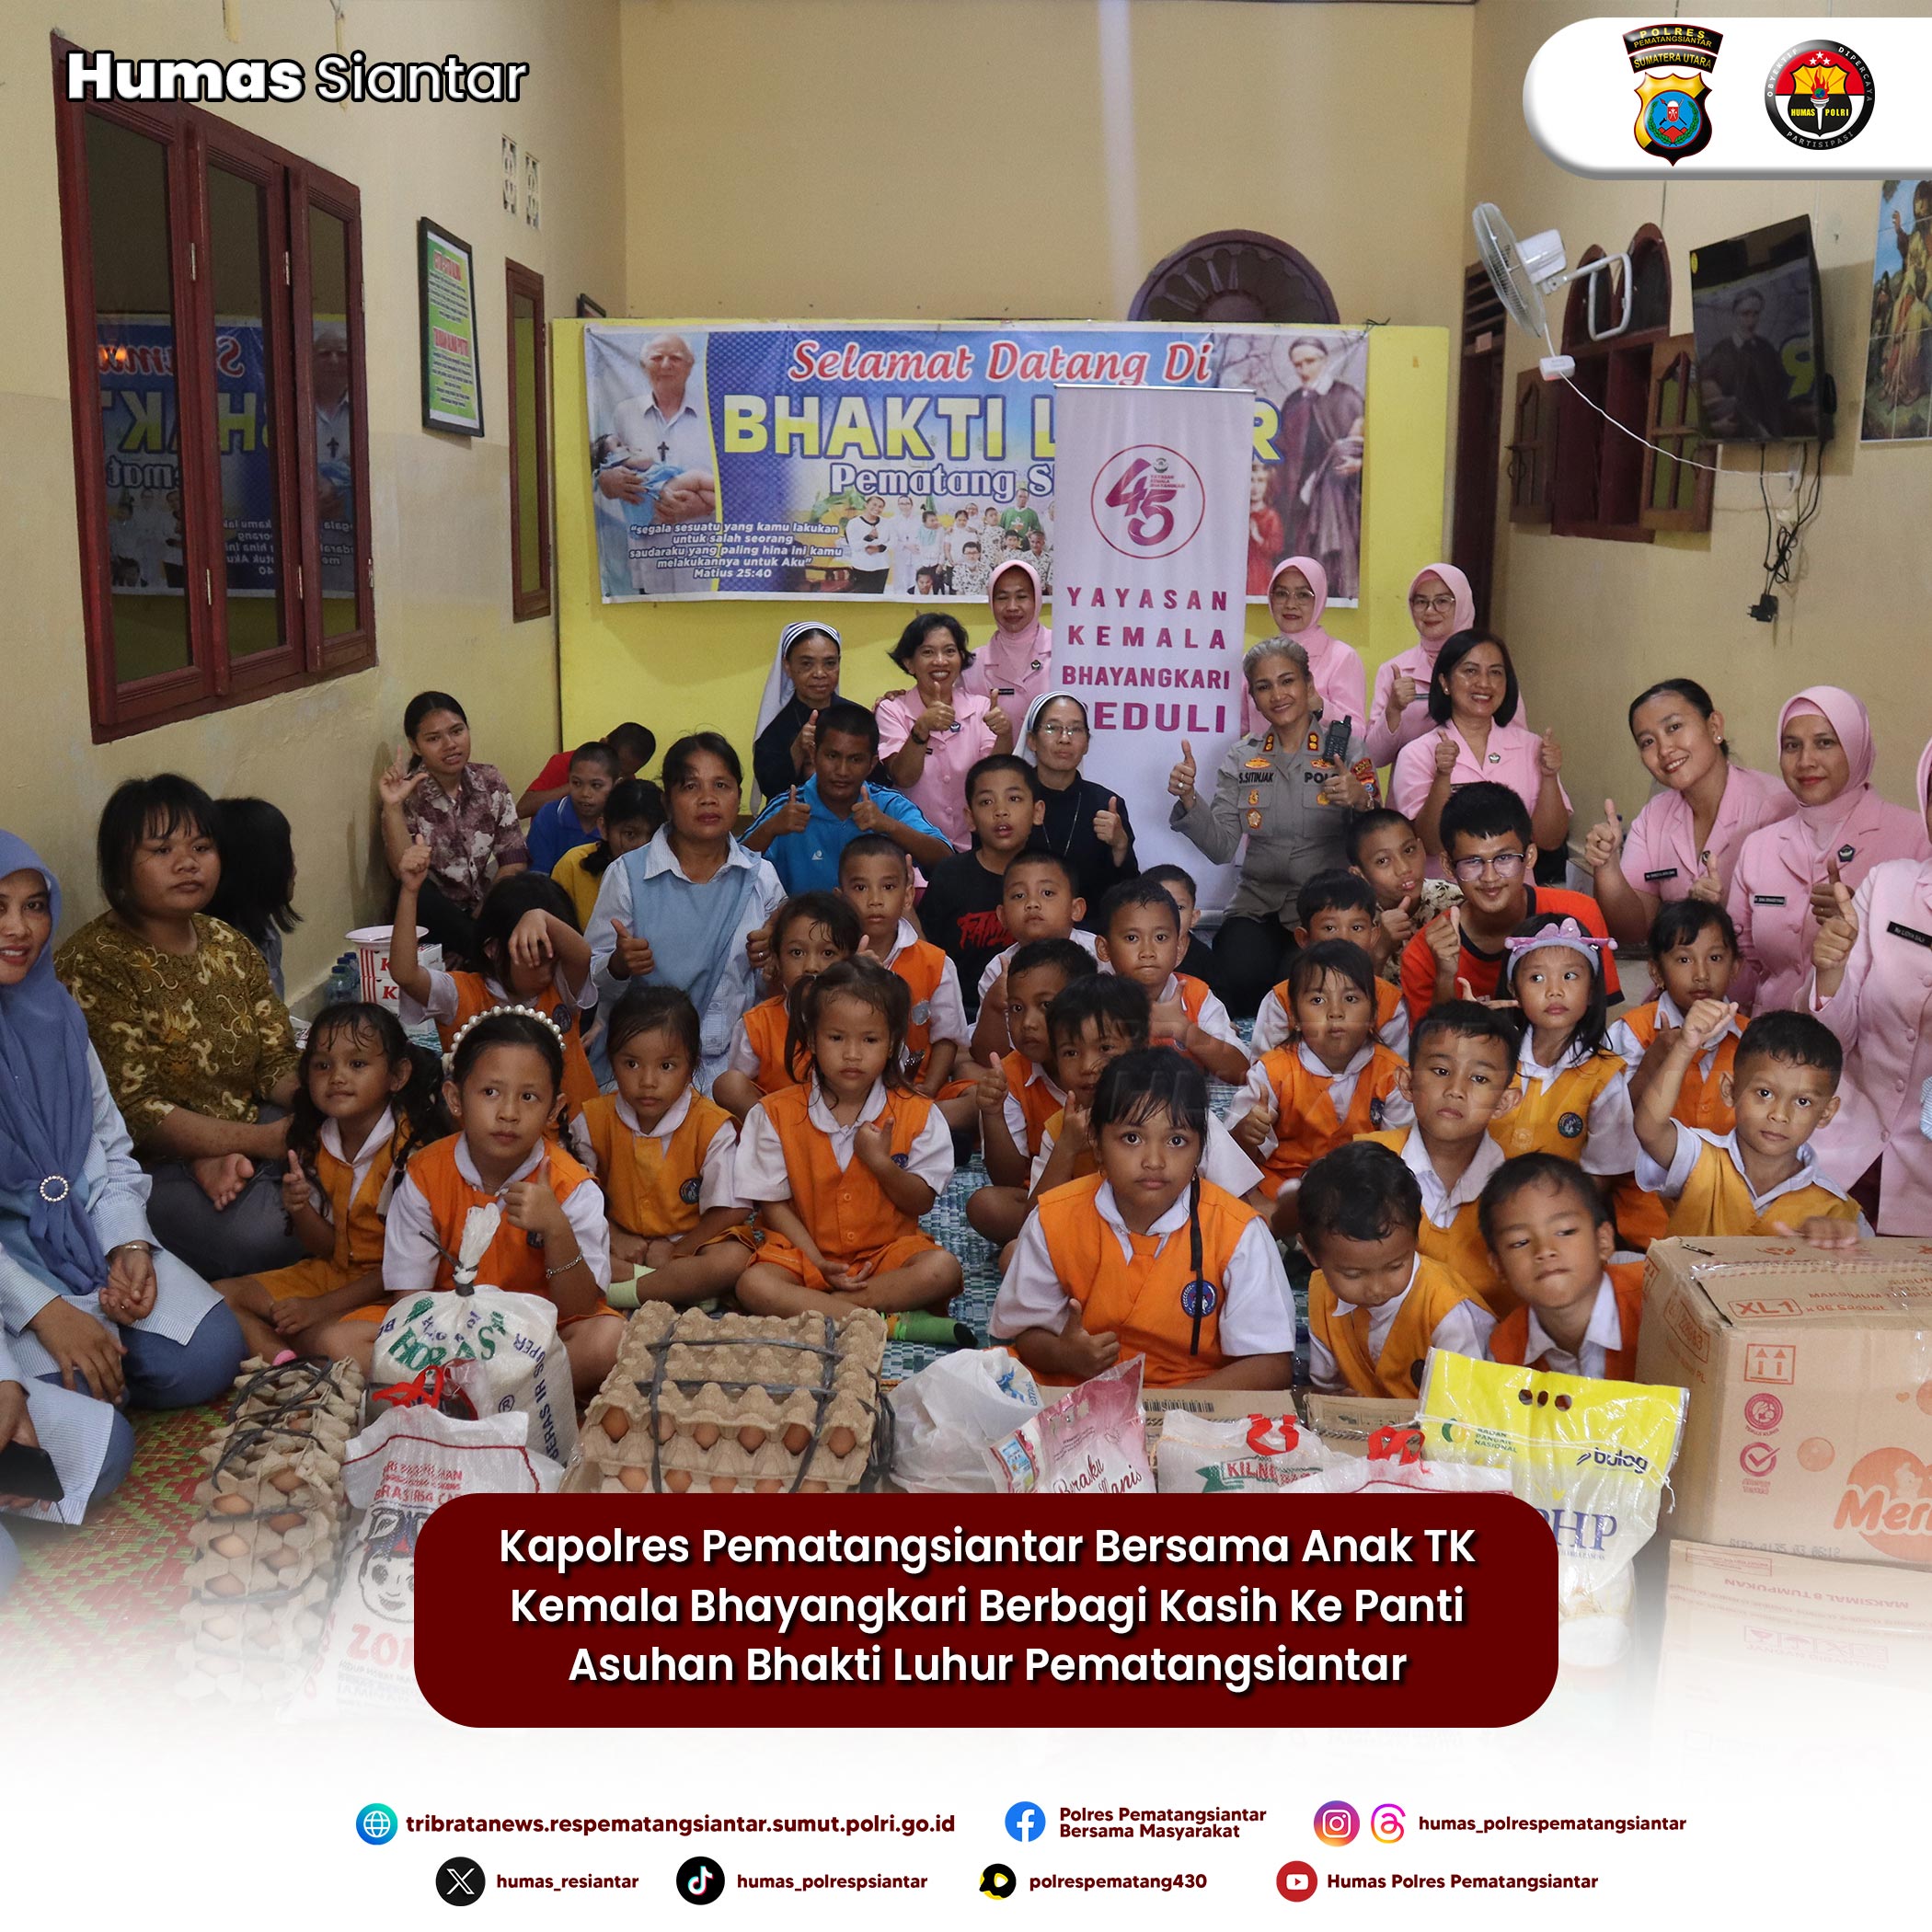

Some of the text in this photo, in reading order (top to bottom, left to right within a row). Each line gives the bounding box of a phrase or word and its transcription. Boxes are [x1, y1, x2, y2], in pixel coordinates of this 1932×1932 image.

[789, 340, 1213, 385] Selamat Datang Di
[723, 394, 1006, 461] BHAKTI
[830, 463, 1016, 503] Pematang
[675, 523, 721, 534] sesuatu
[724, 523, 753, 534] yang
[757, 522, 789, 532] kamu
[793, 523, 838, 534] lakukan
[673, 533, 793, 545] untuk salah seorang
[629, 545, 843, 558] saudaraku yang paling hina ini kamu
[657, 557, 740, 569] melakukannya
[743, 557, 778, 567] untuk
[693, 569, 773, 579] Matius 25:40
[1067, 586, 1227, 612] YAYASAN
[1068, 625, 1226, 650] KEMALA
[1062, 665, 1231, 690] BHAYANGKARI
[1087, 701, 1225, 733] EDULI
[1737, 1299, 1797, 1316] XL1
[1474, 1440, 1517, 1454] NASIONAL
[1593, 1447, 1649, 1474] bulog
[1724, 1578, 1811, 1599] TUMPUKAN
[1826, 1593, 1909, 1609] MAKSIMAL
